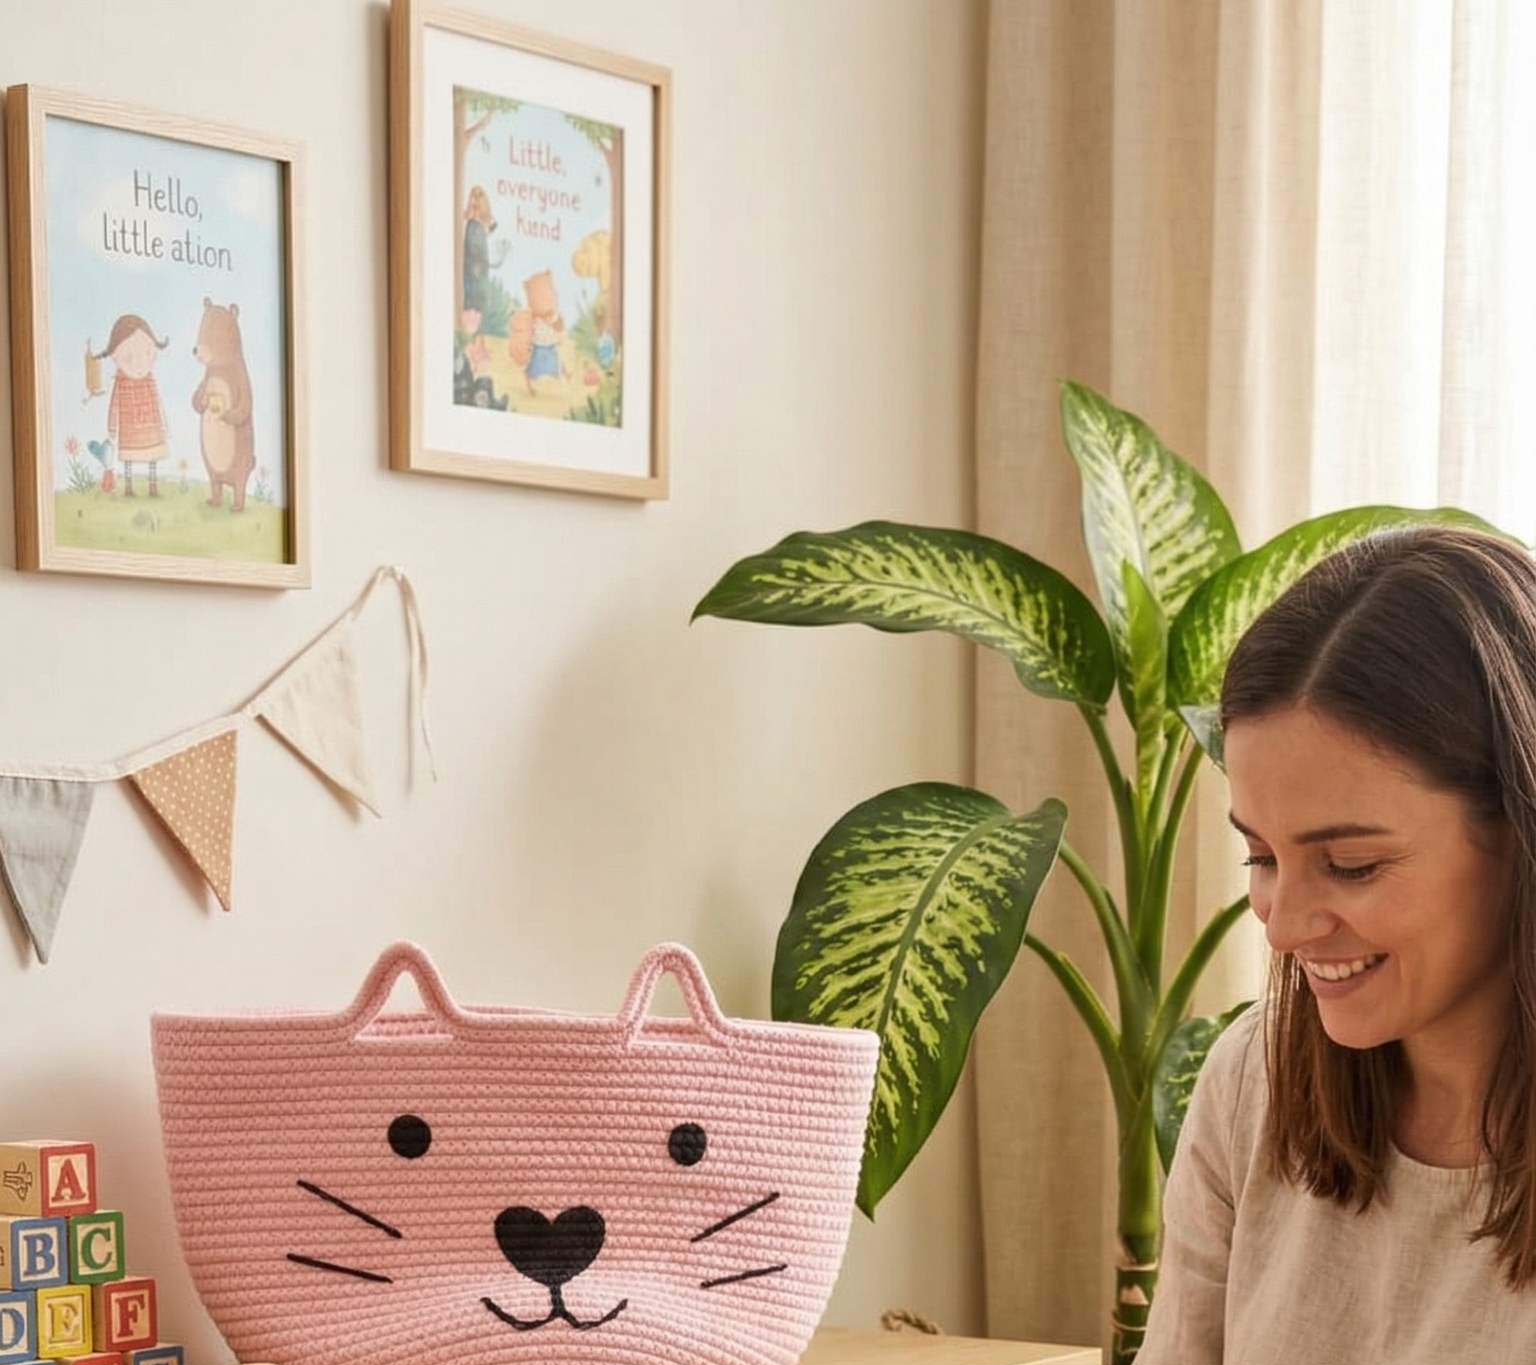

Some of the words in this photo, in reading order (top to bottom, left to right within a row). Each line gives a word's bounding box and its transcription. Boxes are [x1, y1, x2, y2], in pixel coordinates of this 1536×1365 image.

[508, 134, 567, 178] Little,
[133, 169, 203, 223] Hello,
[103, 211, 164, 259] little
[171, 228, 233, 272] ation
[51, 1158, 86, 1203] A
[23, 1233, 55, 1276] B
[81, 1227, 112, 1270] C
[0, 1308, 25, 1350] D
[47, 1302, 79, 1343] E
[114, 1294, 145, 1338] F
